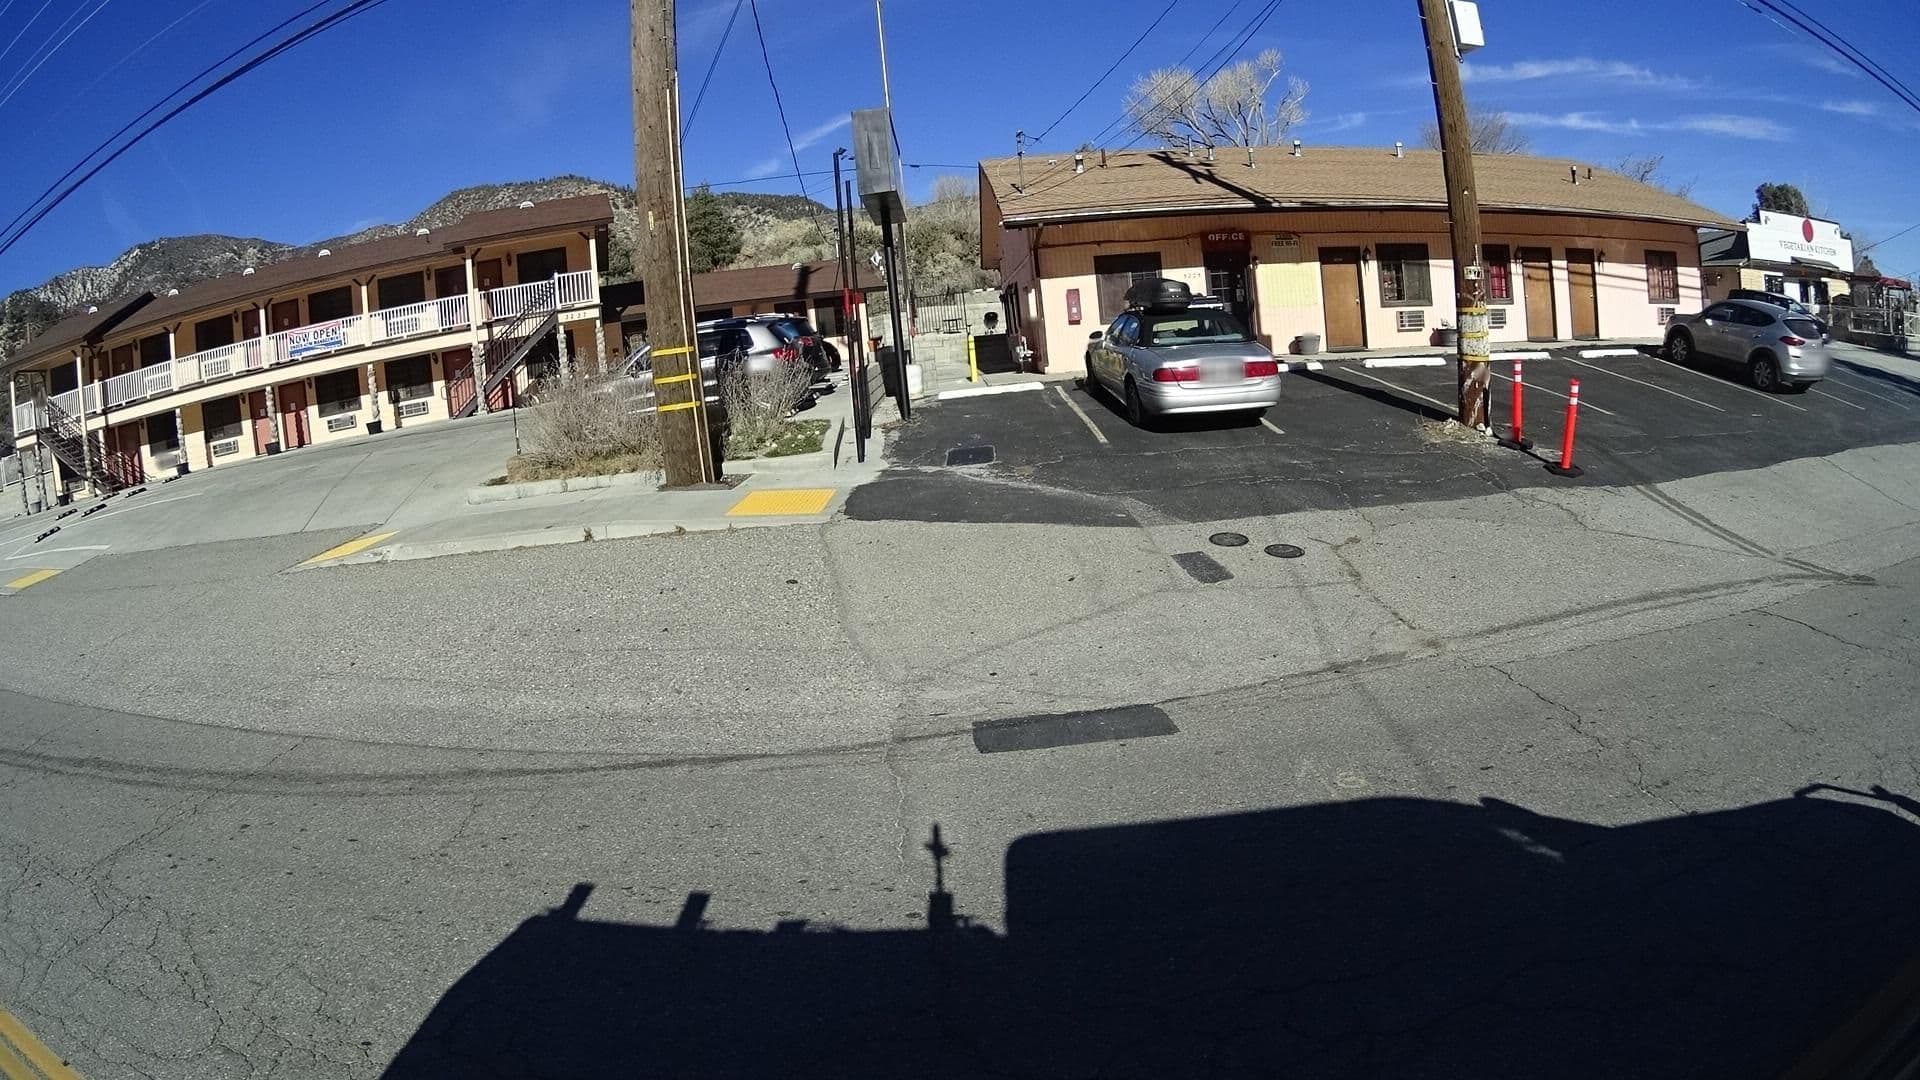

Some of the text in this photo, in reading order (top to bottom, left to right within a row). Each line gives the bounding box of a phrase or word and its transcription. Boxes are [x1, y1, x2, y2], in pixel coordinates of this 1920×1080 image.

[1207, 232, 1246, 241] OFFICE
[1778, 240, 1837, 256] VEGETARIAN KITCHEN
[289, 332, 310, 345] NOW
